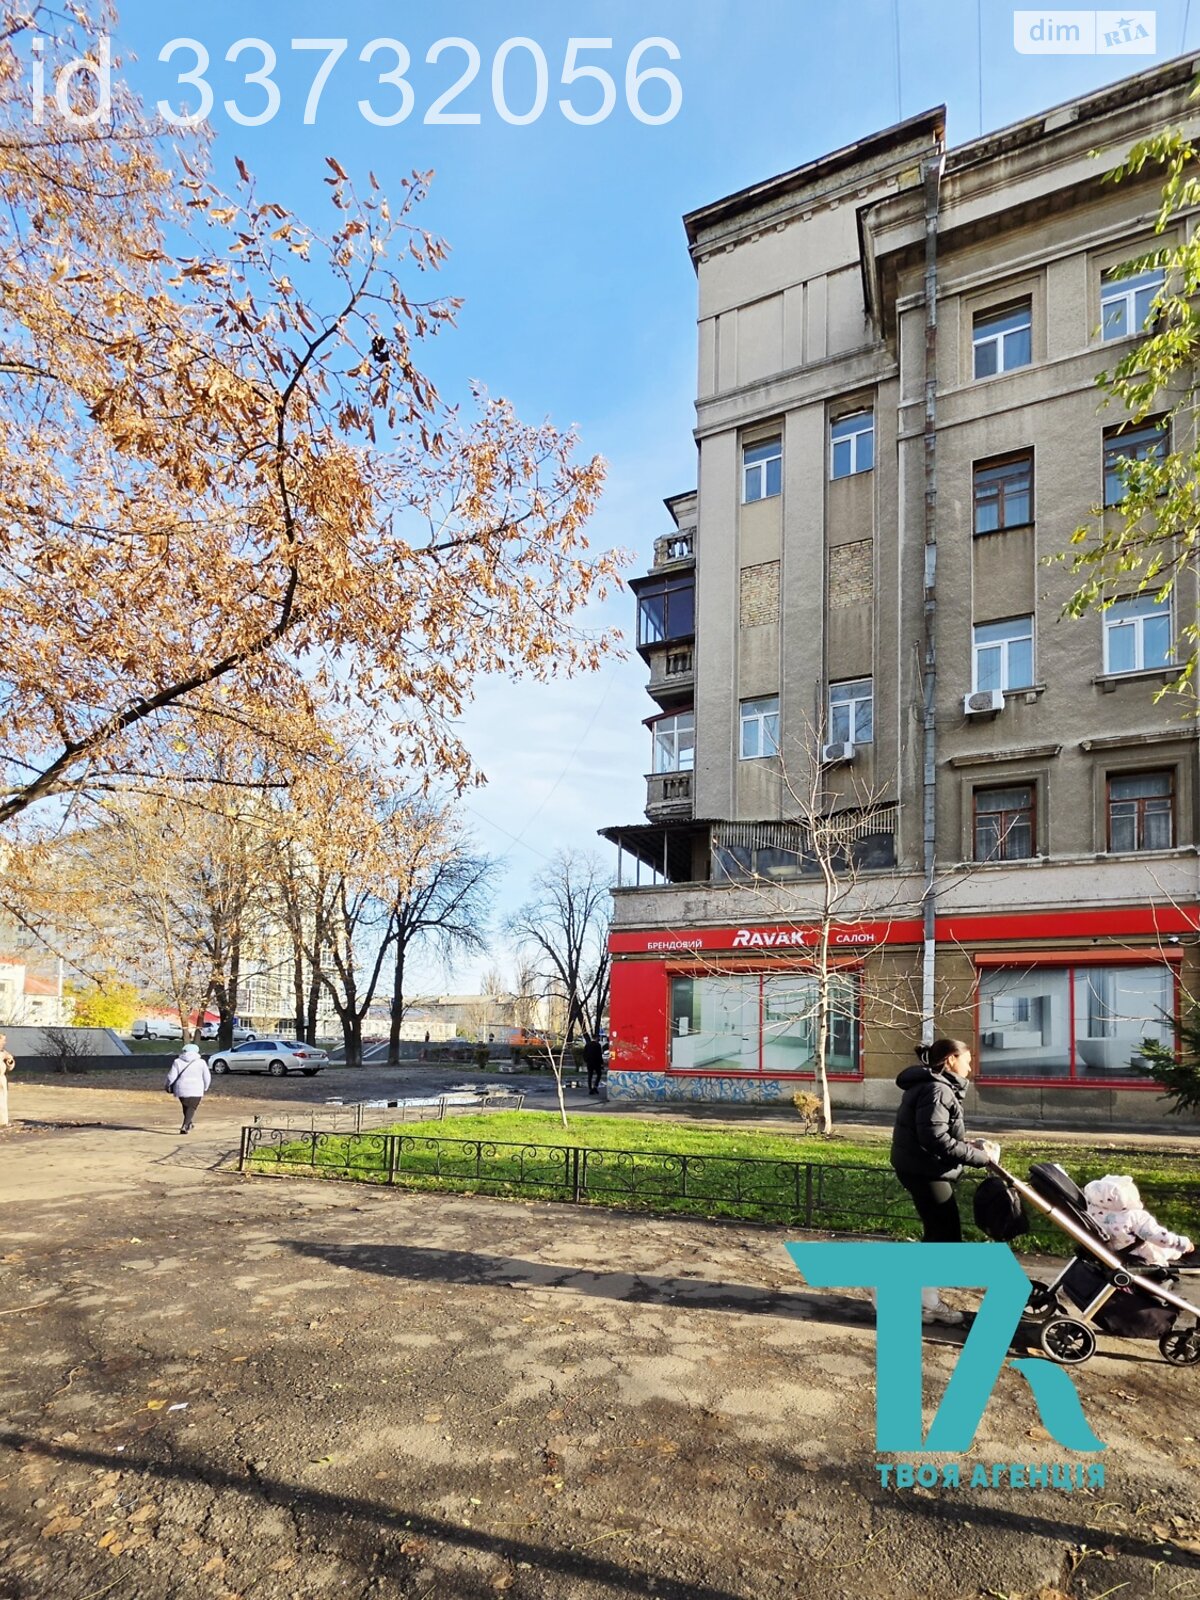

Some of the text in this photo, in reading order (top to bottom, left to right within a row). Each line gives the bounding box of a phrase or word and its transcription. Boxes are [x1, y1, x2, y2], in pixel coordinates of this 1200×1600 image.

[647, 929, 875, 950] БРЕНДОВИЙ RAVAK САЛОН
